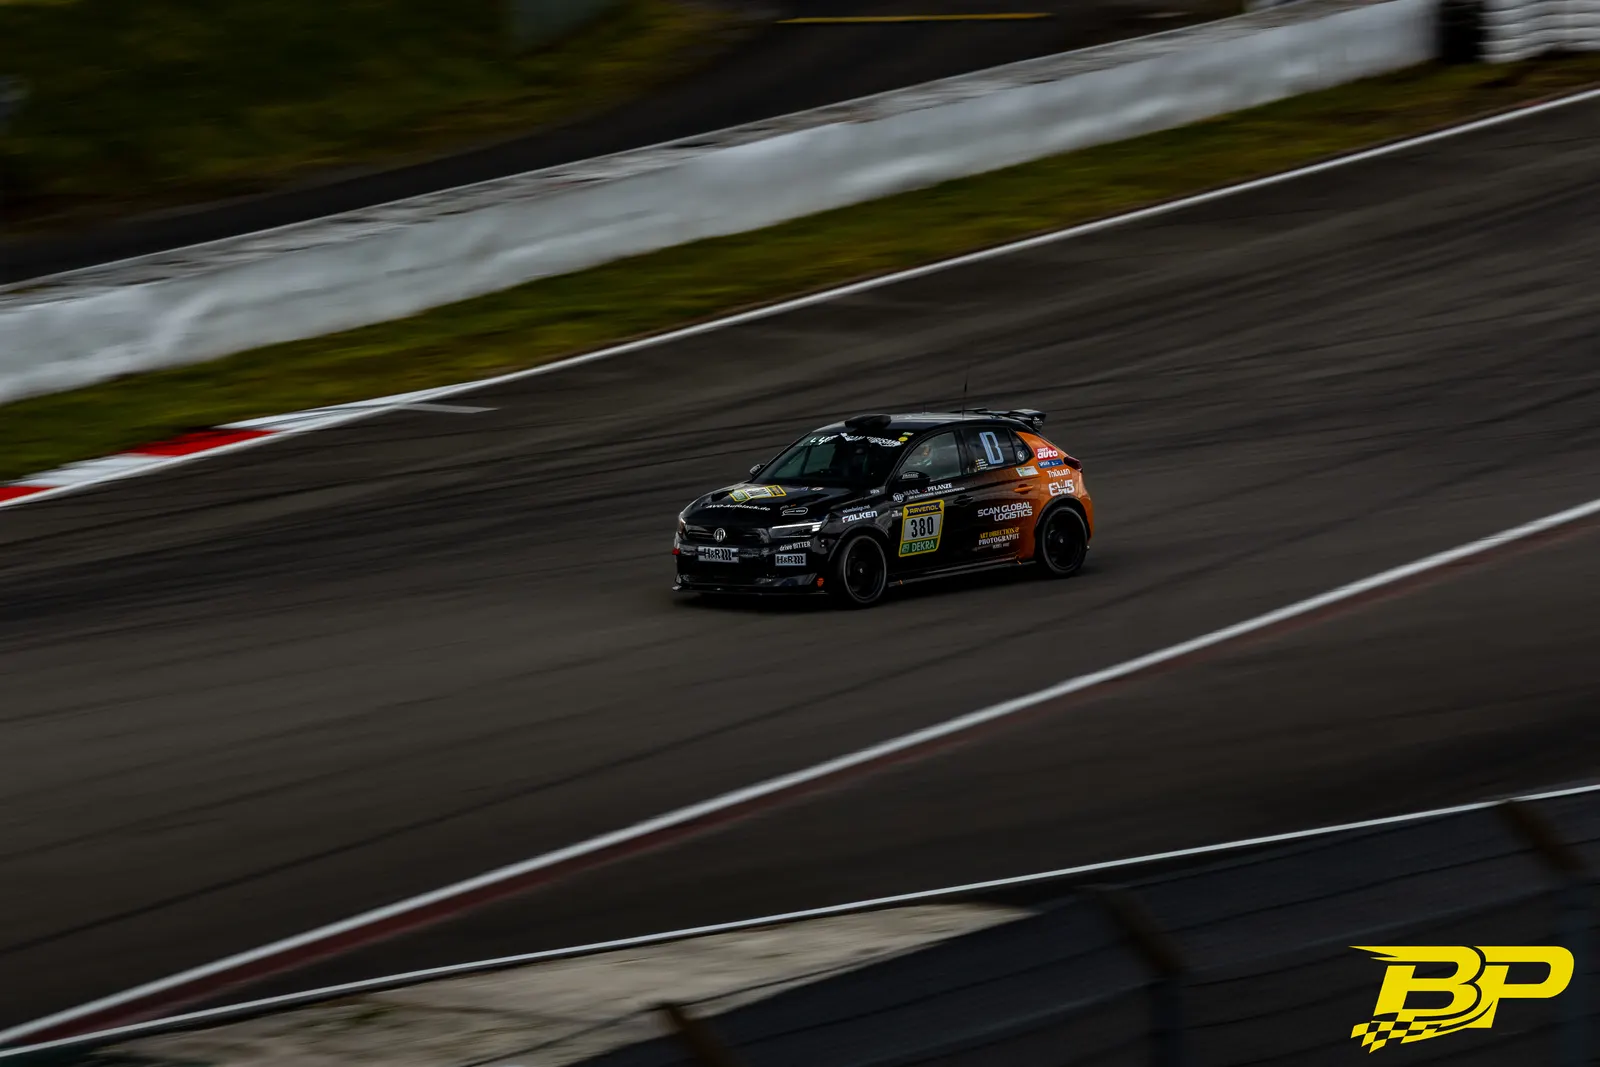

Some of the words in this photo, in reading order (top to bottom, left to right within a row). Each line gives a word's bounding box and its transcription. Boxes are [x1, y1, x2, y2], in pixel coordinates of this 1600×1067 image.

[1037, 450, 1058, 460] auto
[977, 506, 1000, 517] SCAN
[1000, 501, 1033, 513] GLOBAL
[993, 509, 1033, 522] LOGISTICS
[841, 510, 878, 524] FALKEN
[910, 516, 934, 538] 380
[978, 532, 1020, 546] PHOTOGRAPHY
[911, 540, 936, 552] DEKRA
[703, 547, 721, 560] H&R
[776, 555, 794, 565] H&R
